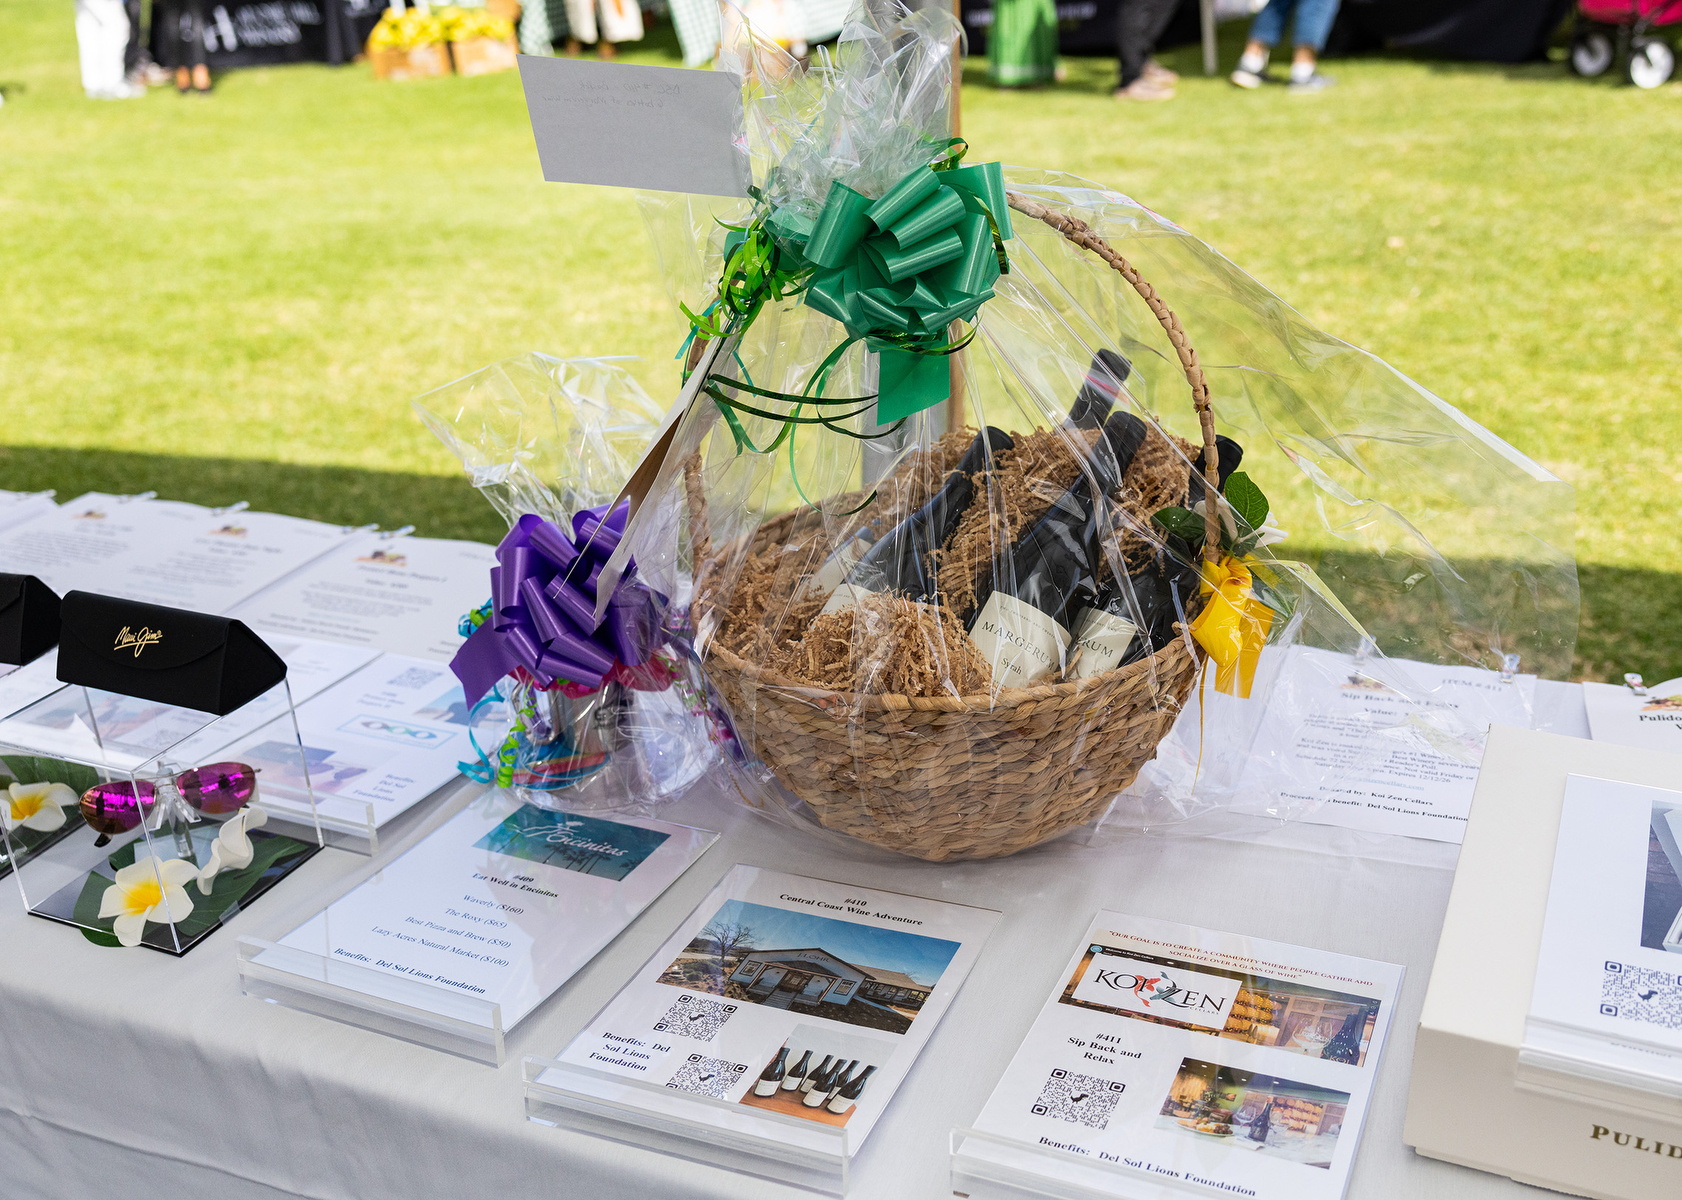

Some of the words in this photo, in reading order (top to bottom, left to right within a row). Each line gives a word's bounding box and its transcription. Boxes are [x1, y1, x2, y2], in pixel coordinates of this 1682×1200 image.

[115, 626, 137, 646] Maui
[982, 620, 1056, 671] MARGERUM
[1001, 656, 1022, 675] Syrah
[1404, 797, 1433, 806] Cellars
[1397, 808, 1420, 816] Lions
[1422, 811, 1468, 822] Foundation
[546, 831, 629, 857] Encinitas
[472, 872, 488, 881] Eat
[490, 876, 509, 886] Well
[509, 881, 518, 889] in
[520, 884, 559, 898] Encinitas
[513, 875, 535, 883] #409
[463, 894, 495, 909] Waverly
[496, 903, 524, 915] ($160)
[780, 893, 816, 906] Central
[816, 901, 844, 911] Coast
[847, 906, 871, 917] Wine
[872, 912, 923, 926] Adventure
[844, 898, 868, 907] #410
[445, 908, 461, 917] The
[461, 912, 483, 923] Roxy
[483, 918, 508, 930] ($65)
[405, 916, 424, 926] Best
[424, 921, 447, 932] Pizza
[447, 927, 465, 937] and
[464, 931, 487, 942] Brew
[487, 938, 512, 949] ($50)
[371, 926, 392, 937] Lazy
[392, 932, 417, 943] Acres
[419, 938, 451, 951] Natural
[449, 946, 481, 960] Market
[479, 955, 510, 968] ($100)
[1130, 935, 1152, 944] GOAL
[1173, 944, 1201, 953] CREATE
[1210, 951, 1260, 964] COMMUNITY
[1261, 961, 1288, 971] WHERE
[1290, 967, 1319, 977] PEOPLE
[1321, 973, 1353, 983] GATHER
[1169, 950, 1209, 961] SOCIALIZE
[1209, 958, 1231, 966] OVER
[1239, 963, 1263, 972] GLASS
[334, 947, 372, 963] Benefits:
[375, 959, 392, 969] Del
[392, 964, 409, 974] Sol
[408, 968, 434, 980] Lions
[434, 975, 486, 994] Foundation
[1093, 968, 1148, 992] KOI
[1160, 982, 1227, 1012] ZEN
[602, 1032, 647, 1047] Benefits:
[651, 1043, 671, 1053] Del
[1067, 1036, 1086, 1047] Sip
[1089, 1041, 1117, 1054] Back
[1120, 1049, 1142, 1059] and
[1096, 1033, 1122, 1044] #411
[589, 1052, 647, 1071] Foundation
[602, 1043, 621, 1053] Sol
[622, 1047, 651, 1060] Lions
[1083, 1051, 1115, 1065] Relax
[1590, 1123, 1682, 1159] PULID
[1039, 1136, 1090, 1156] Benefits:
[1099, 1151, 1119, 1163] Del
[1123, 1157, 1142, 1168] Sol
[1146, 1163, 1180, 1178] Lions
[1184, 1172, 1256, 1197] Foundation
